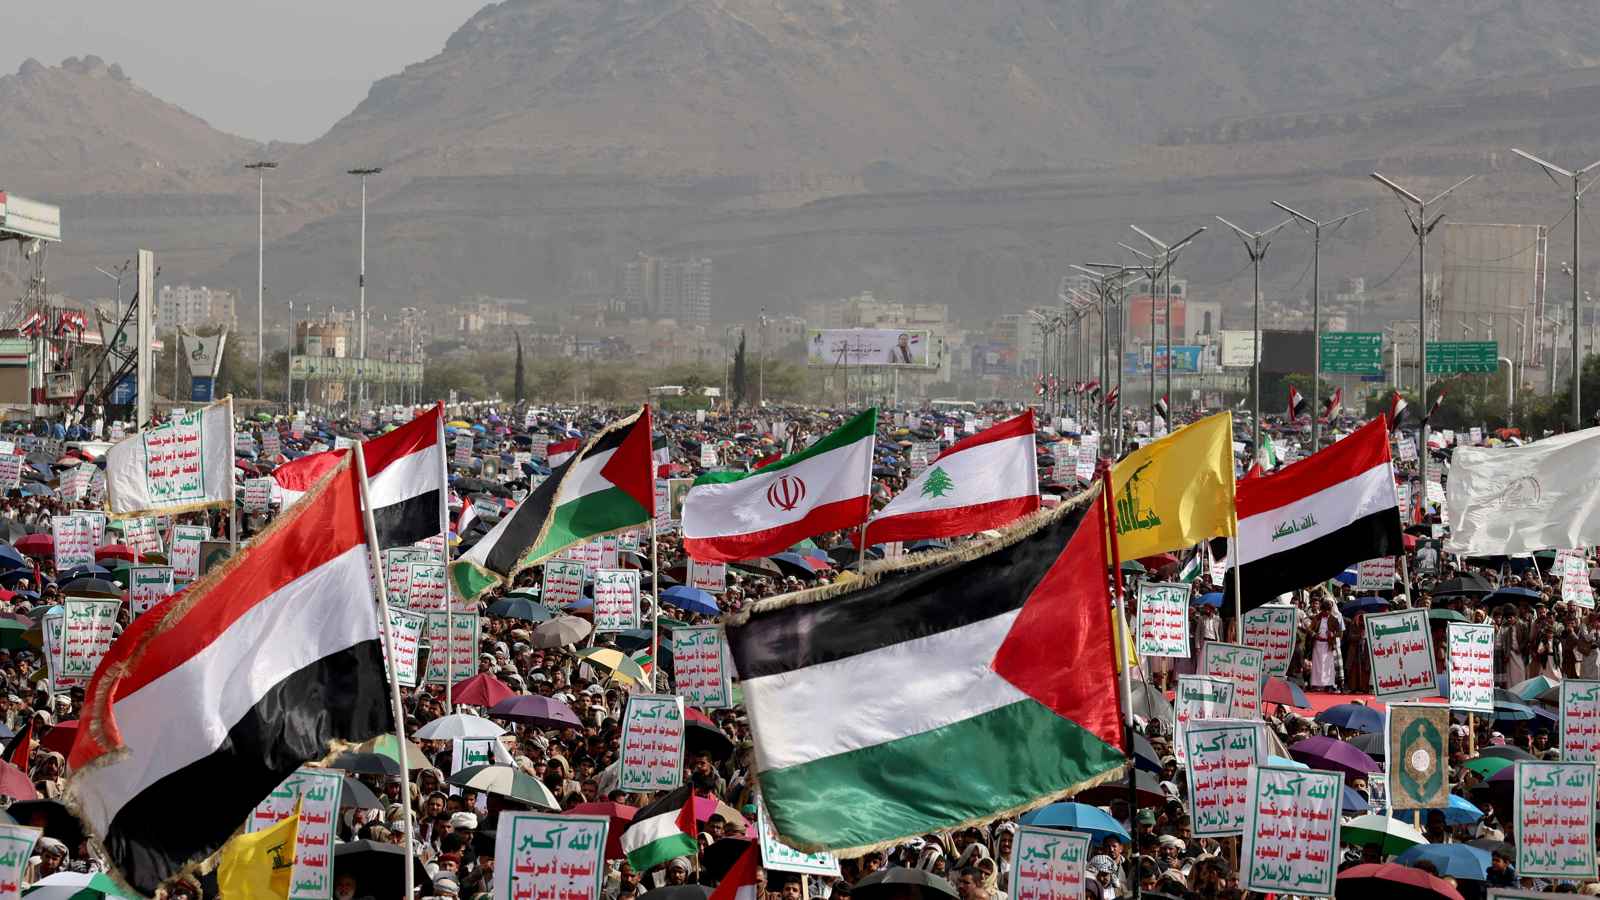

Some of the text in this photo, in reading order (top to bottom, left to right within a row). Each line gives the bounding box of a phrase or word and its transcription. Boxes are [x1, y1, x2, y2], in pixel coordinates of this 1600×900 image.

[1262, 774, 1334, 800] الله أكبر
[1260, 801, 1332, 821] الموت لأمريكا
[518, 824, 600, 855] الله أكبر
[1258, 823, 1331, 841] الموت لإسرائيل
[1256, 845, 1328, 862] اللعنة على اليهود
[515, 856, 595, 878] الموت لأمريكا
[1254, 864, 1328, 886] النصر للإسلام
